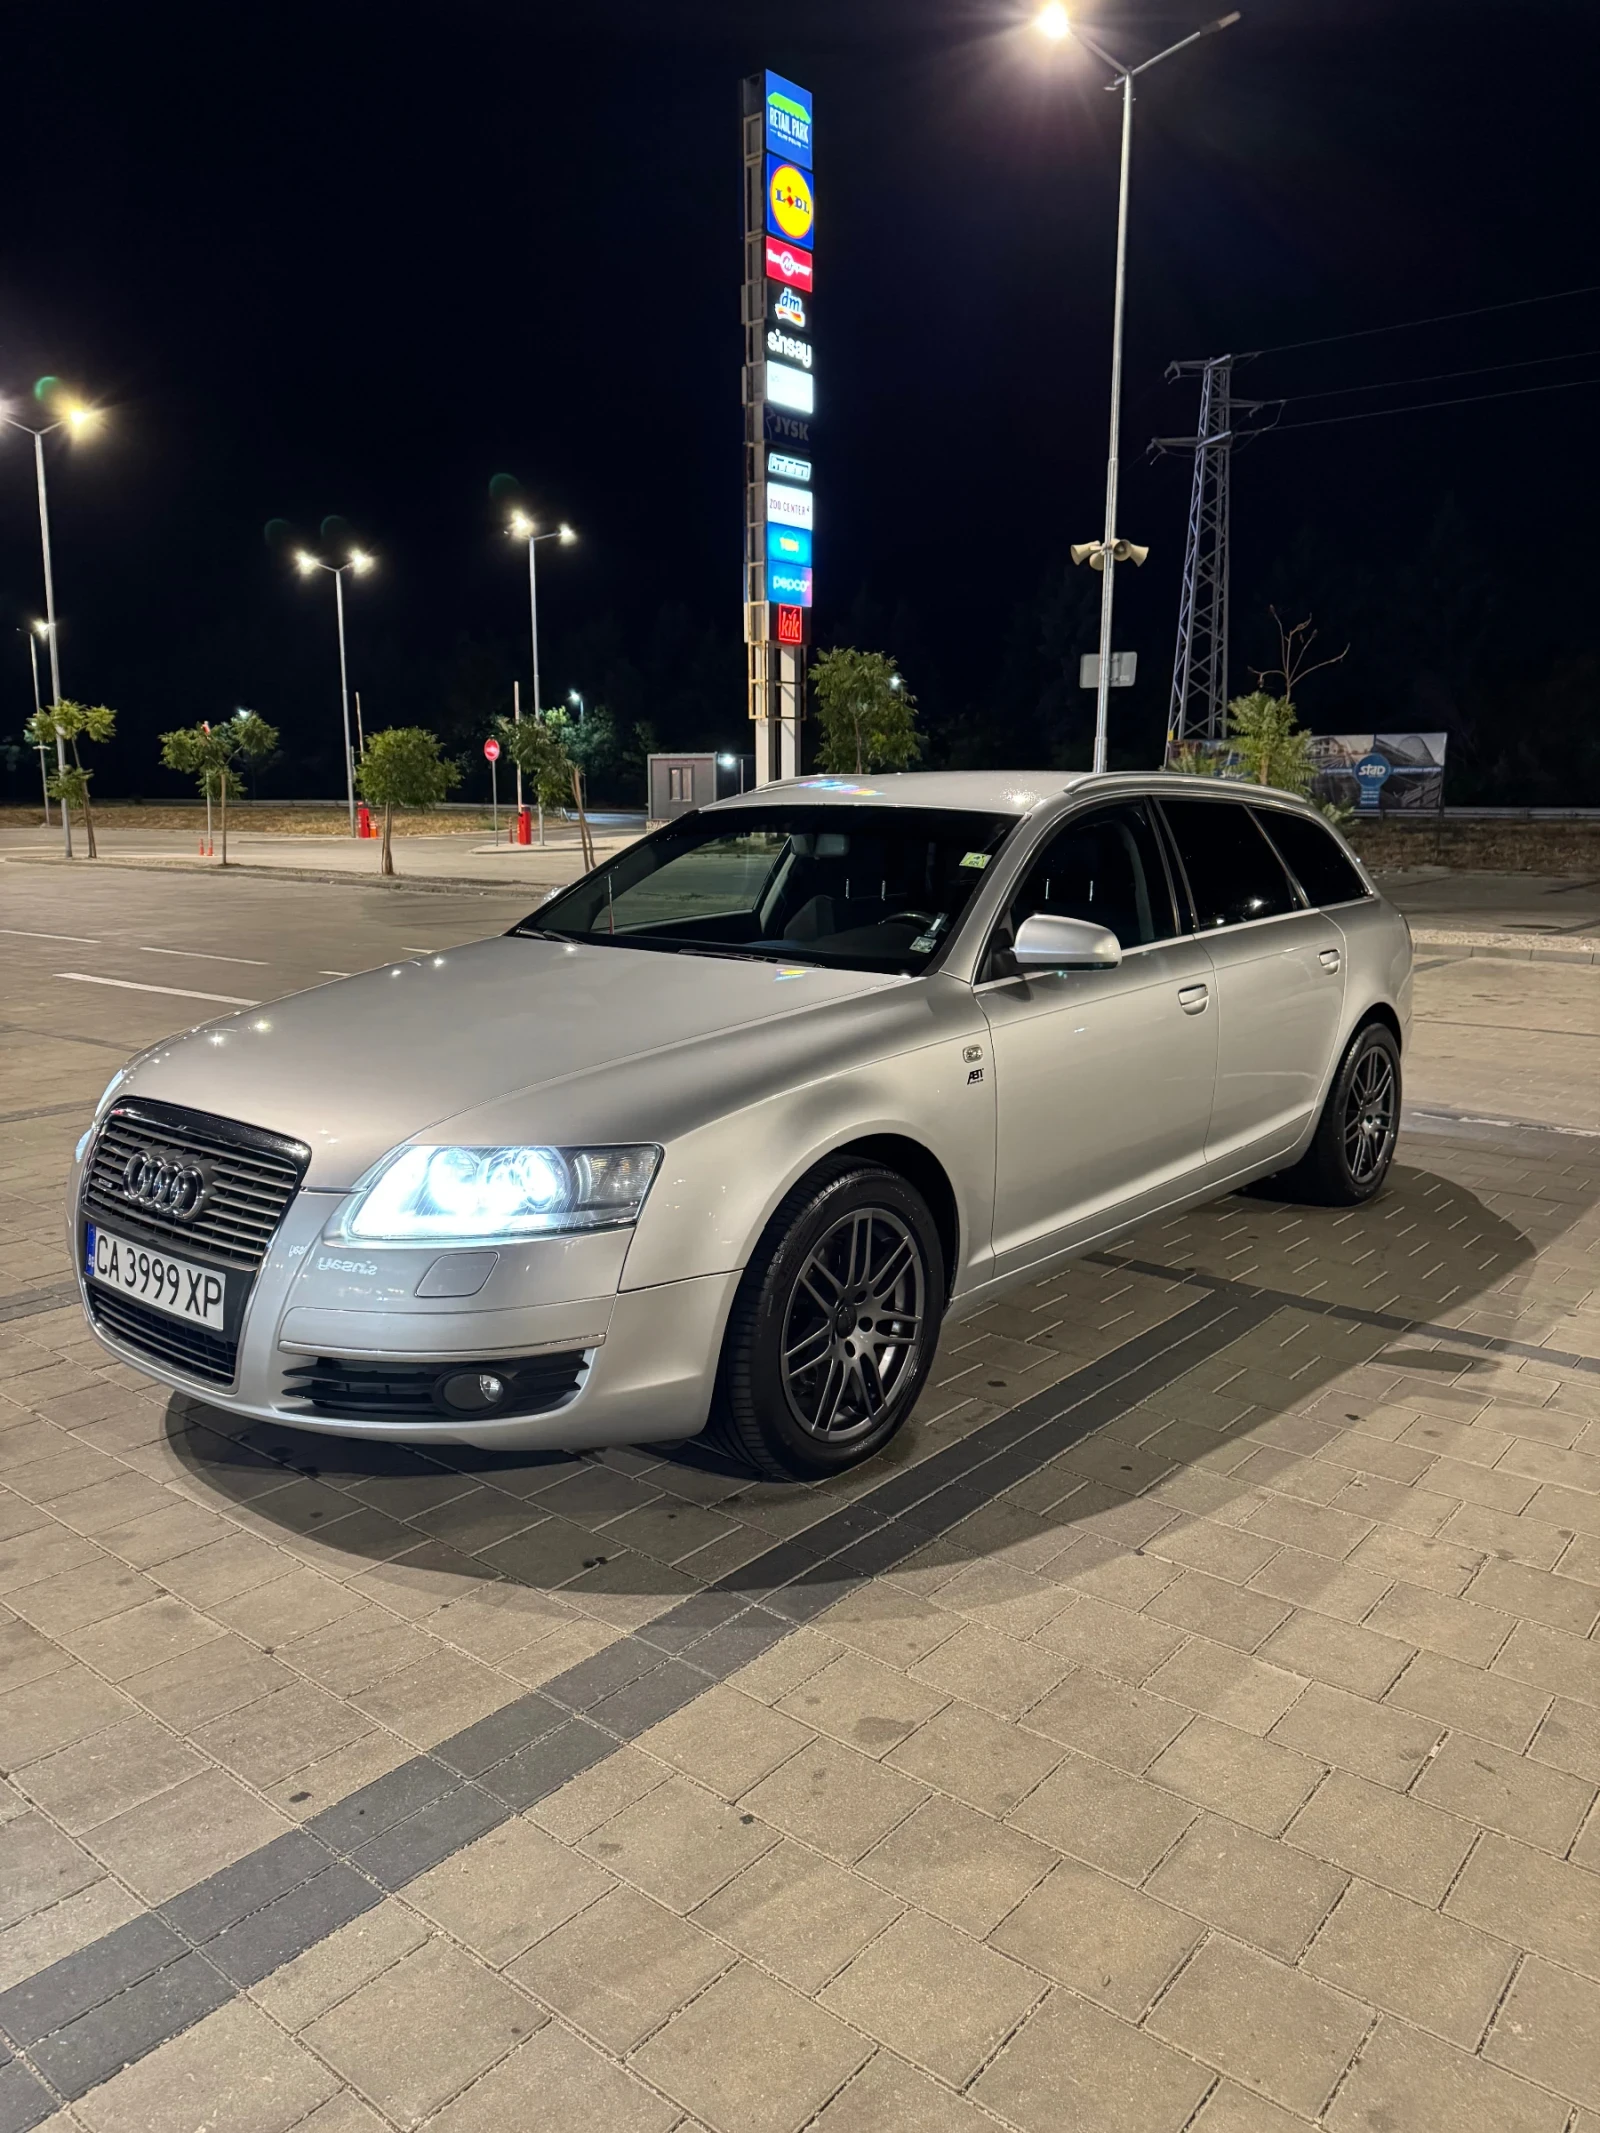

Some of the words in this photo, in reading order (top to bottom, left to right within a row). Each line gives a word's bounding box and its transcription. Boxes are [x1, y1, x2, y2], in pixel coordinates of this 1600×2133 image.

[769, 106, 791, 135] RETAIL
[792, 117, 809, 144] PARK
[780, 288, 802, 312] dm
[767, 328, 812, 369] sinsay
[774, 415, 809, 441] JYSK
[769, 498, 782, 510] ZOO
[783, 501, 806, 516] CENTER
[773, 575, 807, 593] pepco
[781, 609, 800, 638] kik
[967, 1068, 983, 1085] ABT
[97, 1235, 120, 1284] CA
[125, 1251, 180, 1305] 3999
[186, 1269, 222, 1318] XP
